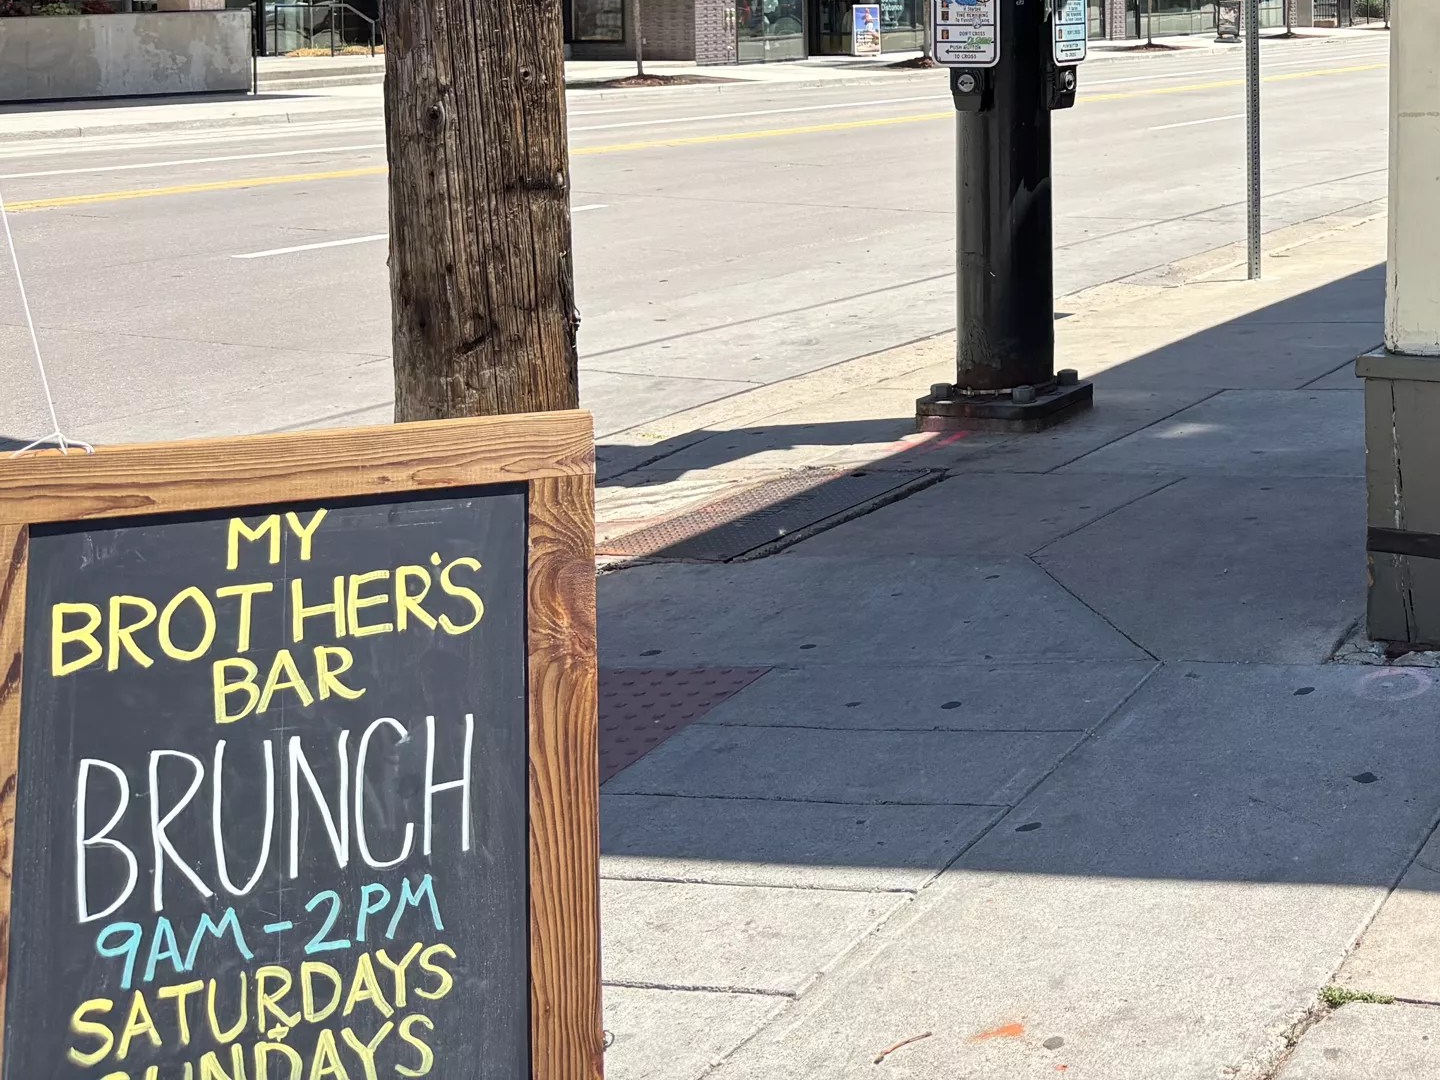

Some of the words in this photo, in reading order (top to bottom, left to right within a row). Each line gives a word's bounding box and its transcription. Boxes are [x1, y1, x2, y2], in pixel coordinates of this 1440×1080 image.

[881, 3, 902, 11] Distance
[226, 507, 328, 570] MY
[51, 551, 485, 677] BROTHER'S
[212, 645, 367, 725] BAR
[76, 712, 474, 924] BRUNCH
[66, 941, 458, 1068] SATURDAYS
[96, 1013, 435, 1080] NDAYS
